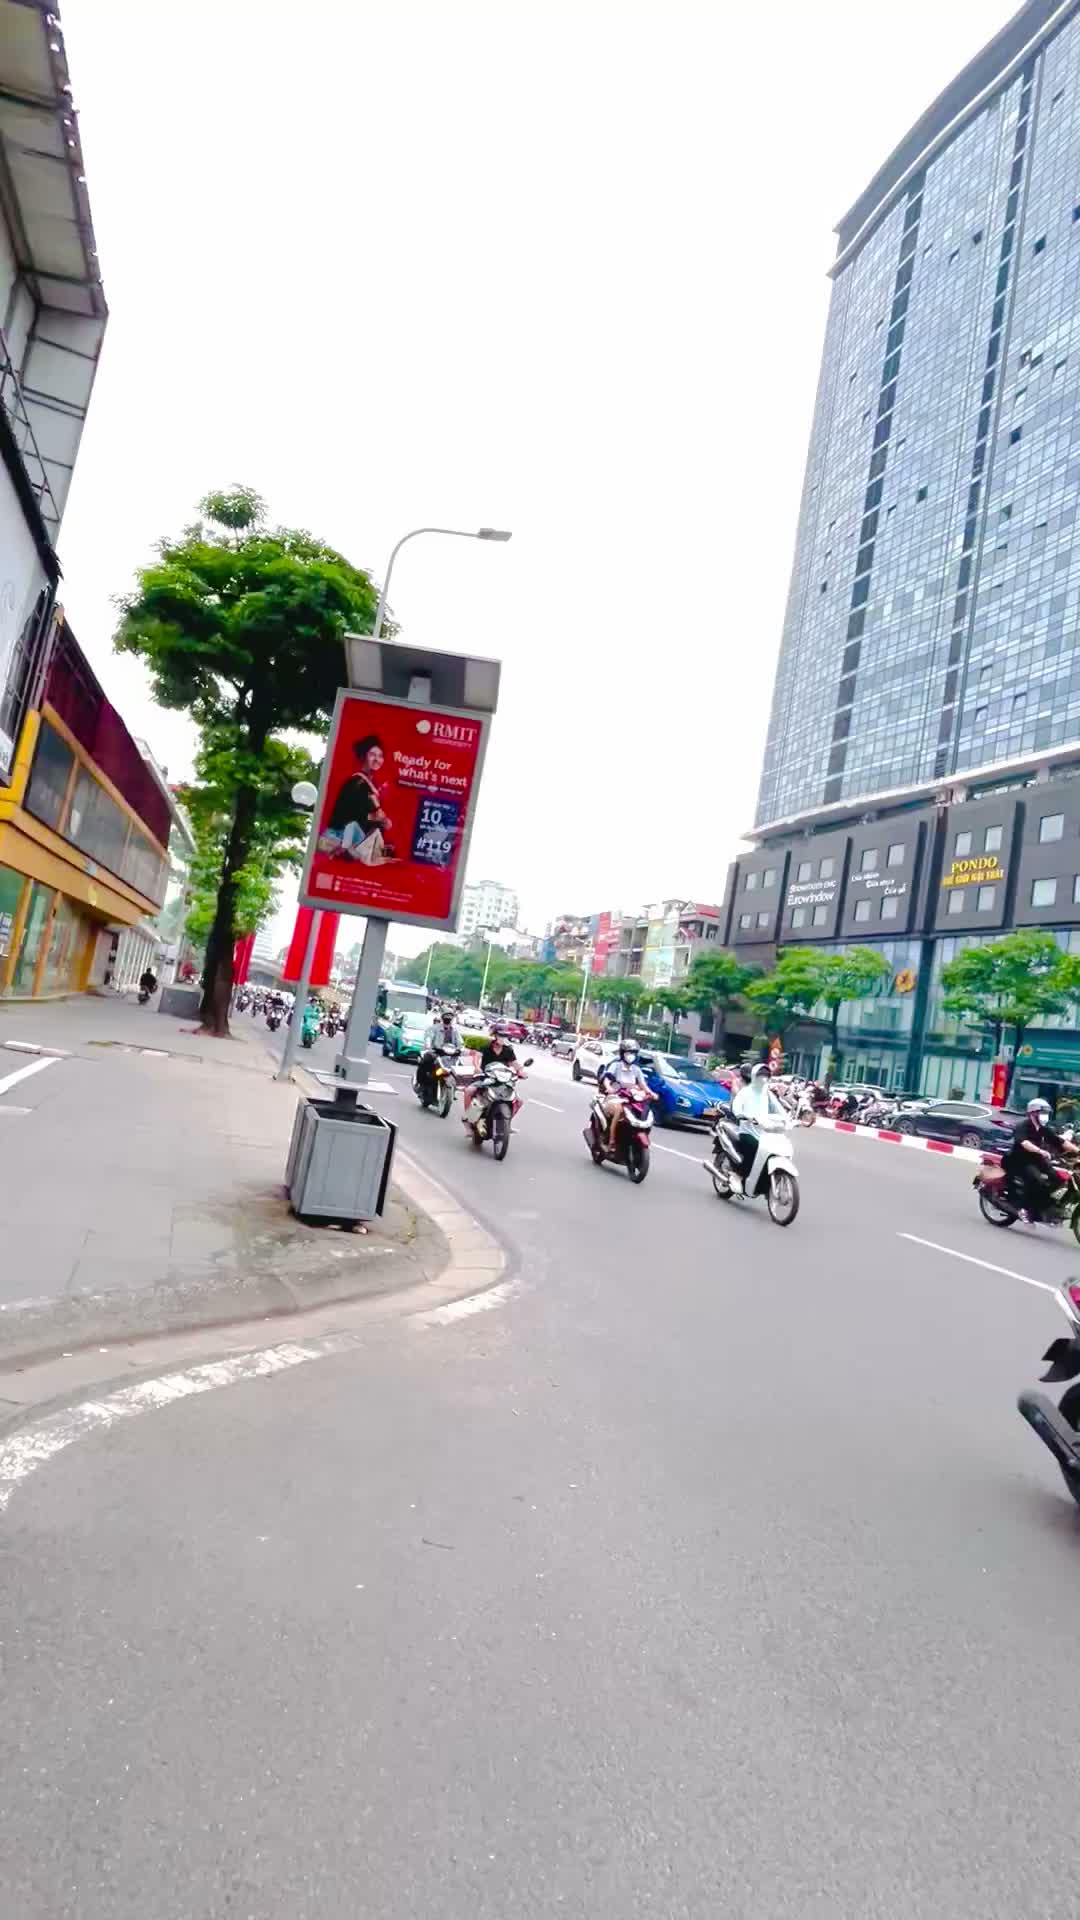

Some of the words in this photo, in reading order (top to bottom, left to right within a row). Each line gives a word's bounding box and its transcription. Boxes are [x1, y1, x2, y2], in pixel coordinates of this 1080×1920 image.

[432, 721, 477, 741] RMIT
[393, 750, 431, 769] Ready
[434, 759, 452, 770] for
[398, 767, 437, 782] what's
[441, 775, 468, 787] next
[421, 808, 442, 824] 10
[416, 837, 452, 853] #119
[951, 856, 997, 873] PONDO
